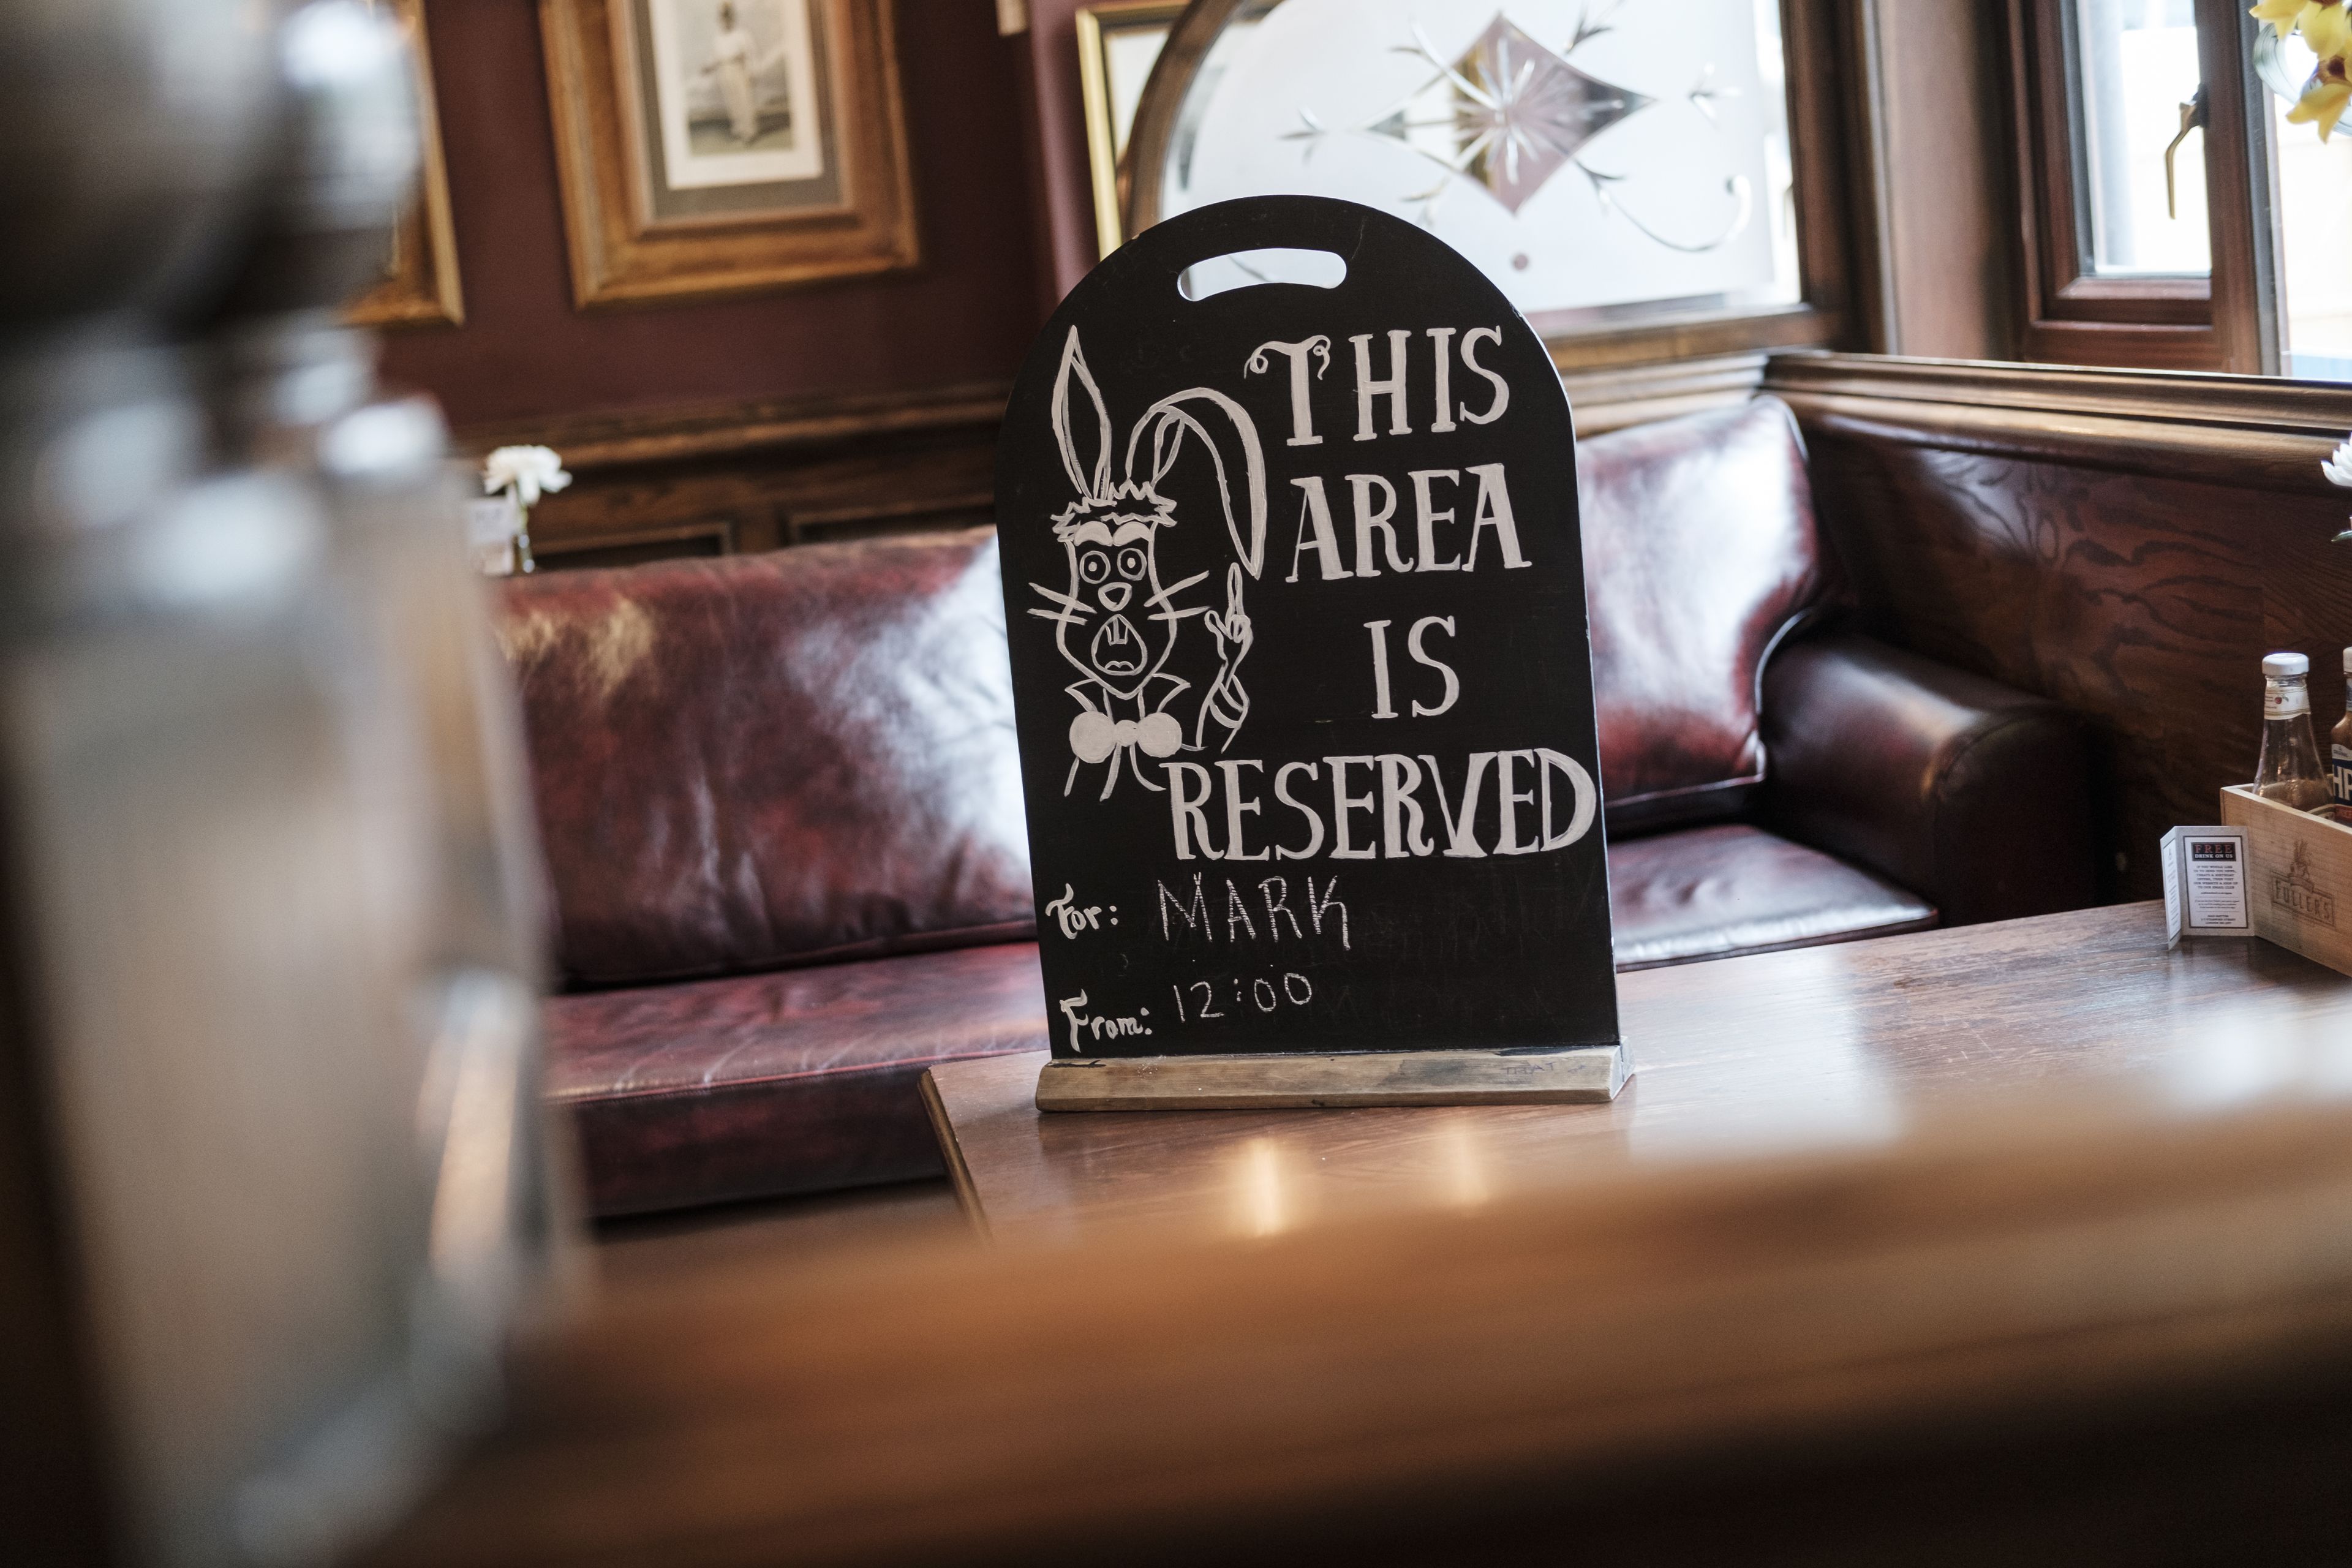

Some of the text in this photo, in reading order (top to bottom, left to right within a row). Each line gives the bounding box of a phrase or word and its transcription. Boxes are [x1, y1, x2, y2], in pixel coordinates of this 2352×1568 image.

[1243, 325, 1509, 446] THIS
[1285, 463, 1532, 583] AREA
[1363, 615, 1460, 719] IS
[1159, 748, 1597, 861] RESERVED
[2194, 843, 2233, 853] FREE
[1045, 871, 1351, 951] For: MARK
[1060, 973, 1313, 1053] From: 12:00
